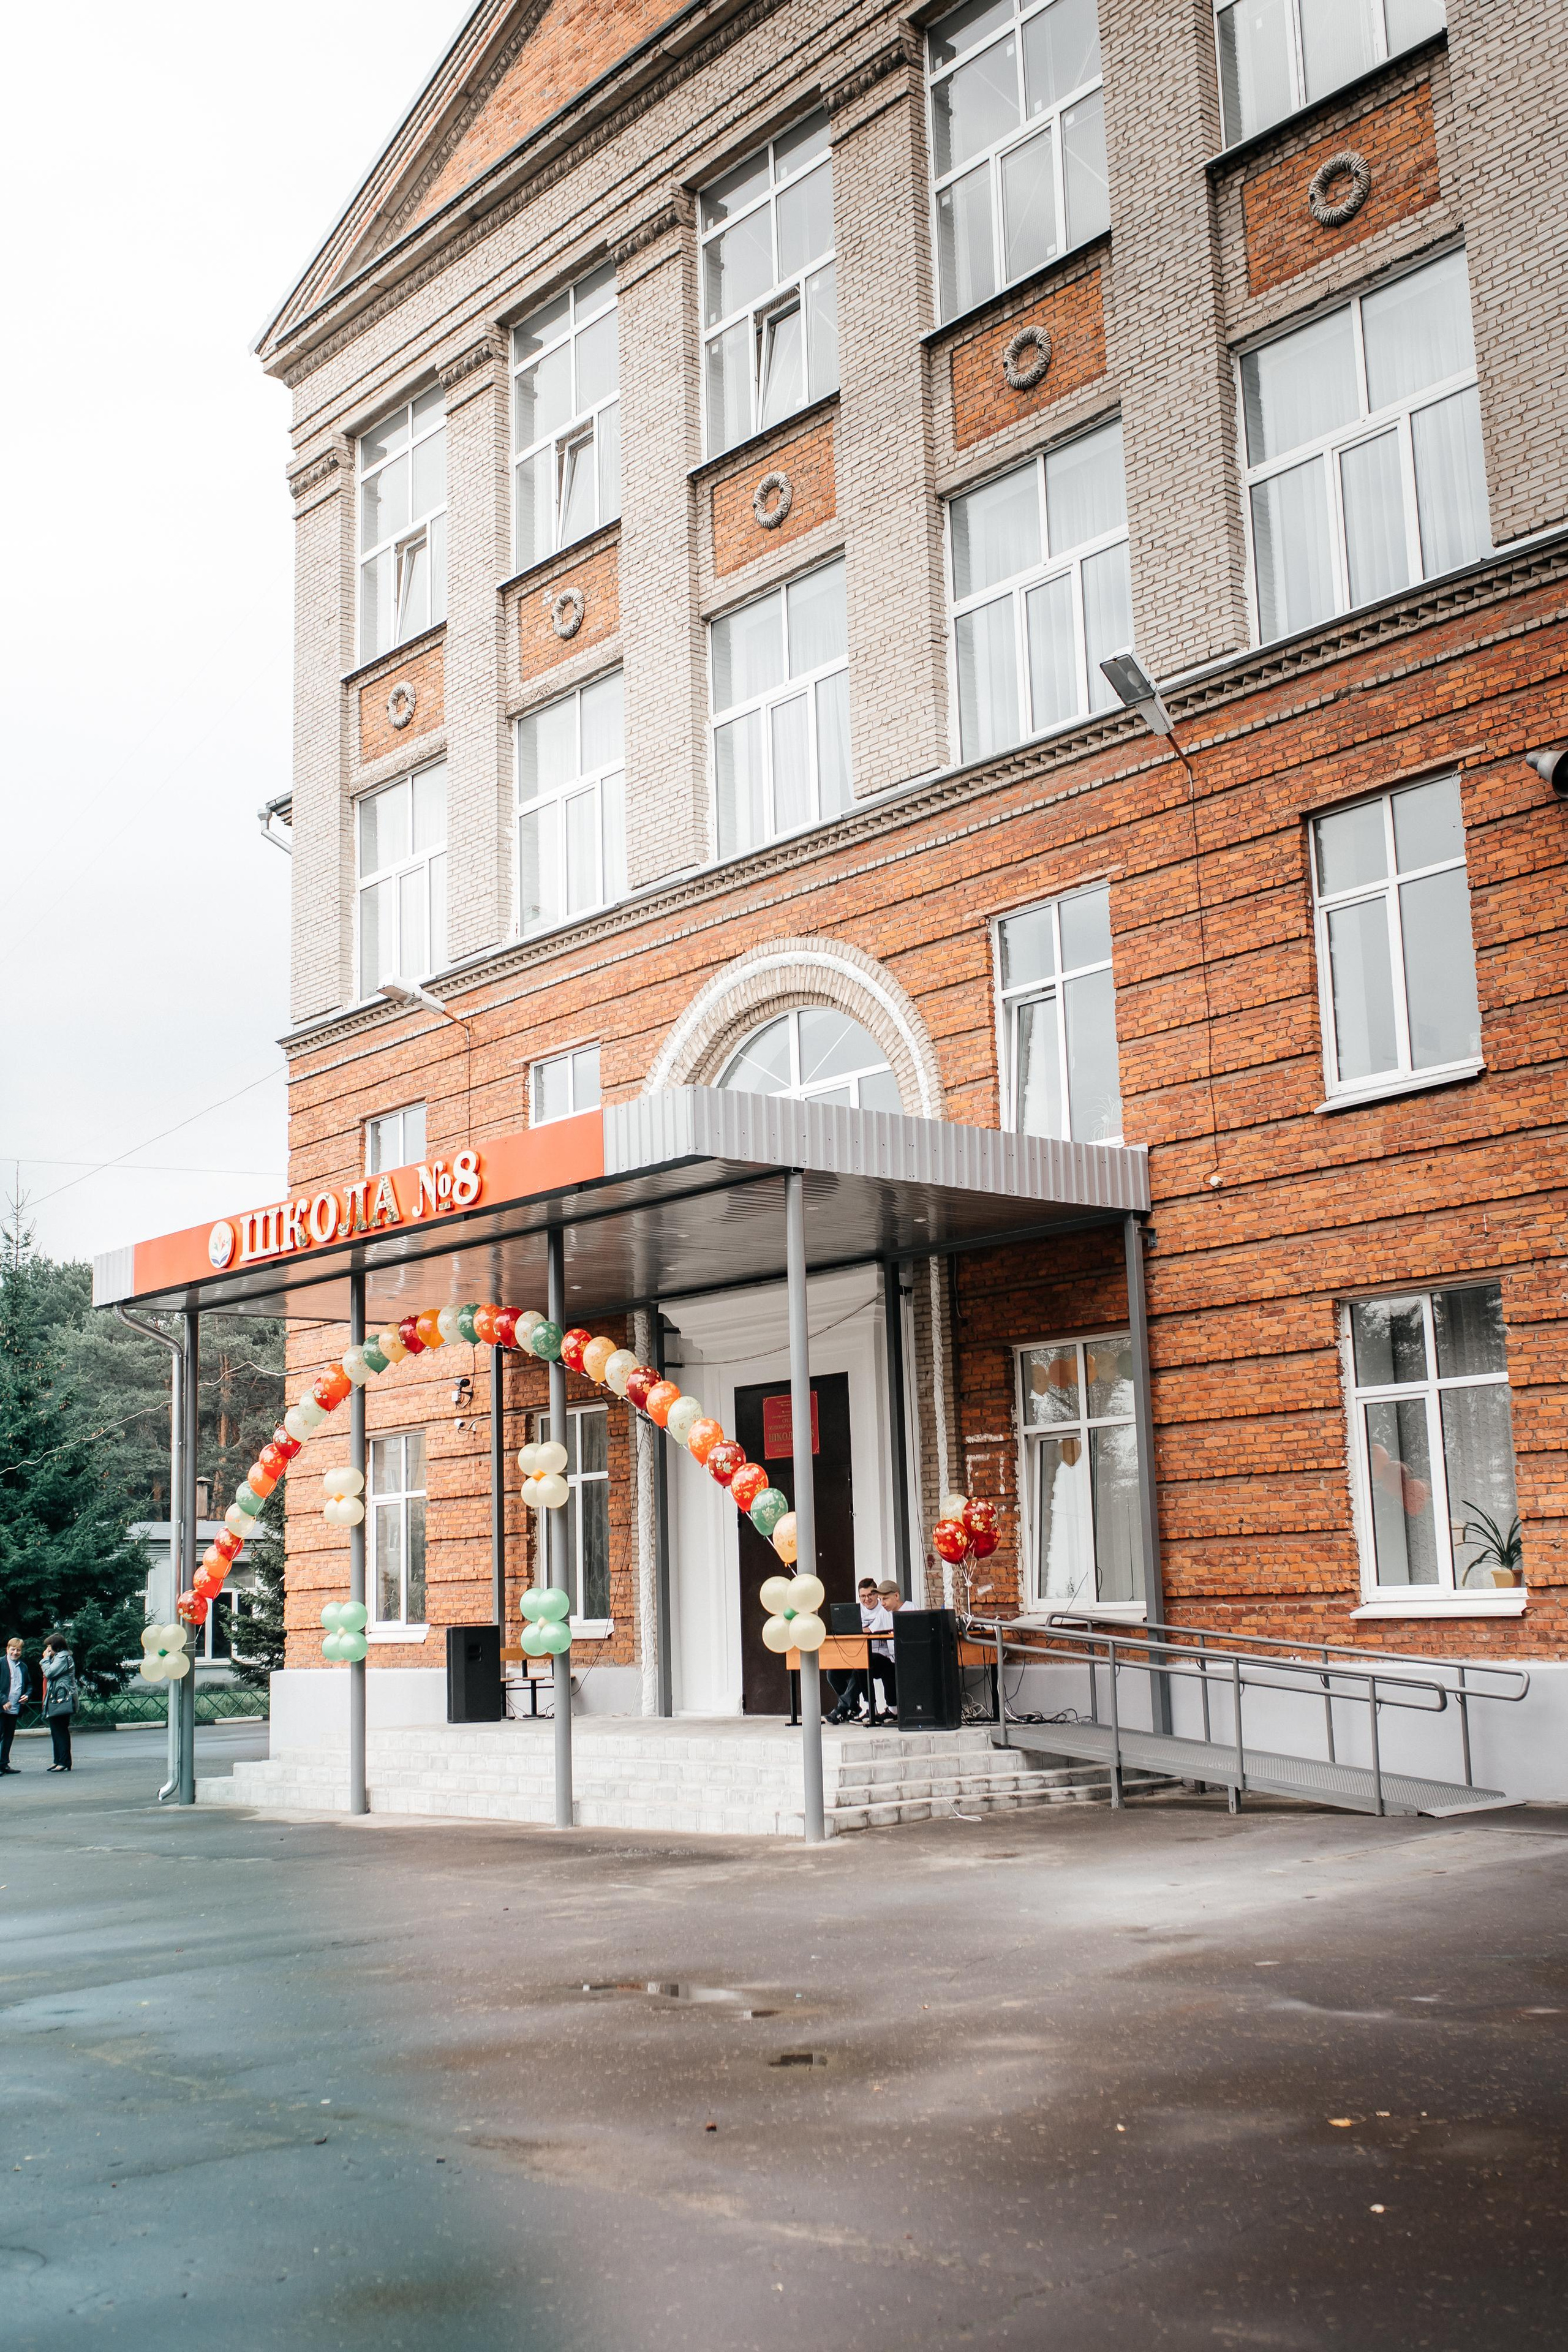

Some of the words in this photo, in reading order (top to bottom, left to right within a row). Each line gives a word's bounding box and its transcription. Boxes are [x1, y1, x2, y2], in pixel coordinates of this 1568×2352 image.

[239, 1175, 400, 1262] ШКОЛА
[412, 1150, 481, 1218] №8
[769, 1431, 793, 1442] ШКОЛ
